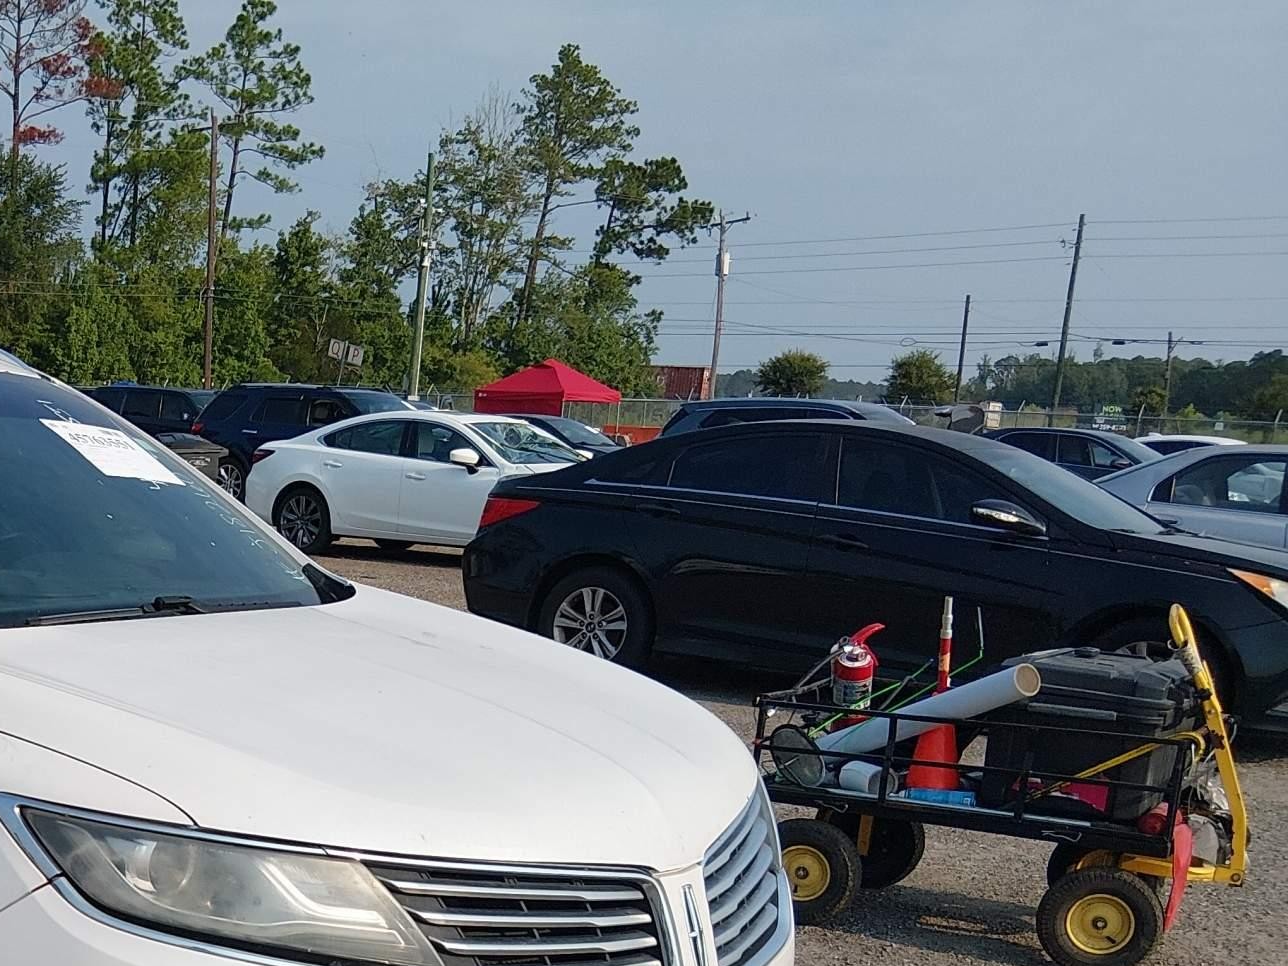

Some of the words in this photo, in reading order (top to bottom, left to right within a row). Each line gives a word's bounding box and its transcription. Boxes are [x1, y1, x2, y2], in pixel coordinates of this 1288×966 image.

[331, 341, 341, 359] Q
[351, 347, 360, 361] P
[1102, 405, 1123, 413] NOW
[67, 432, 136, 451] 45763551
